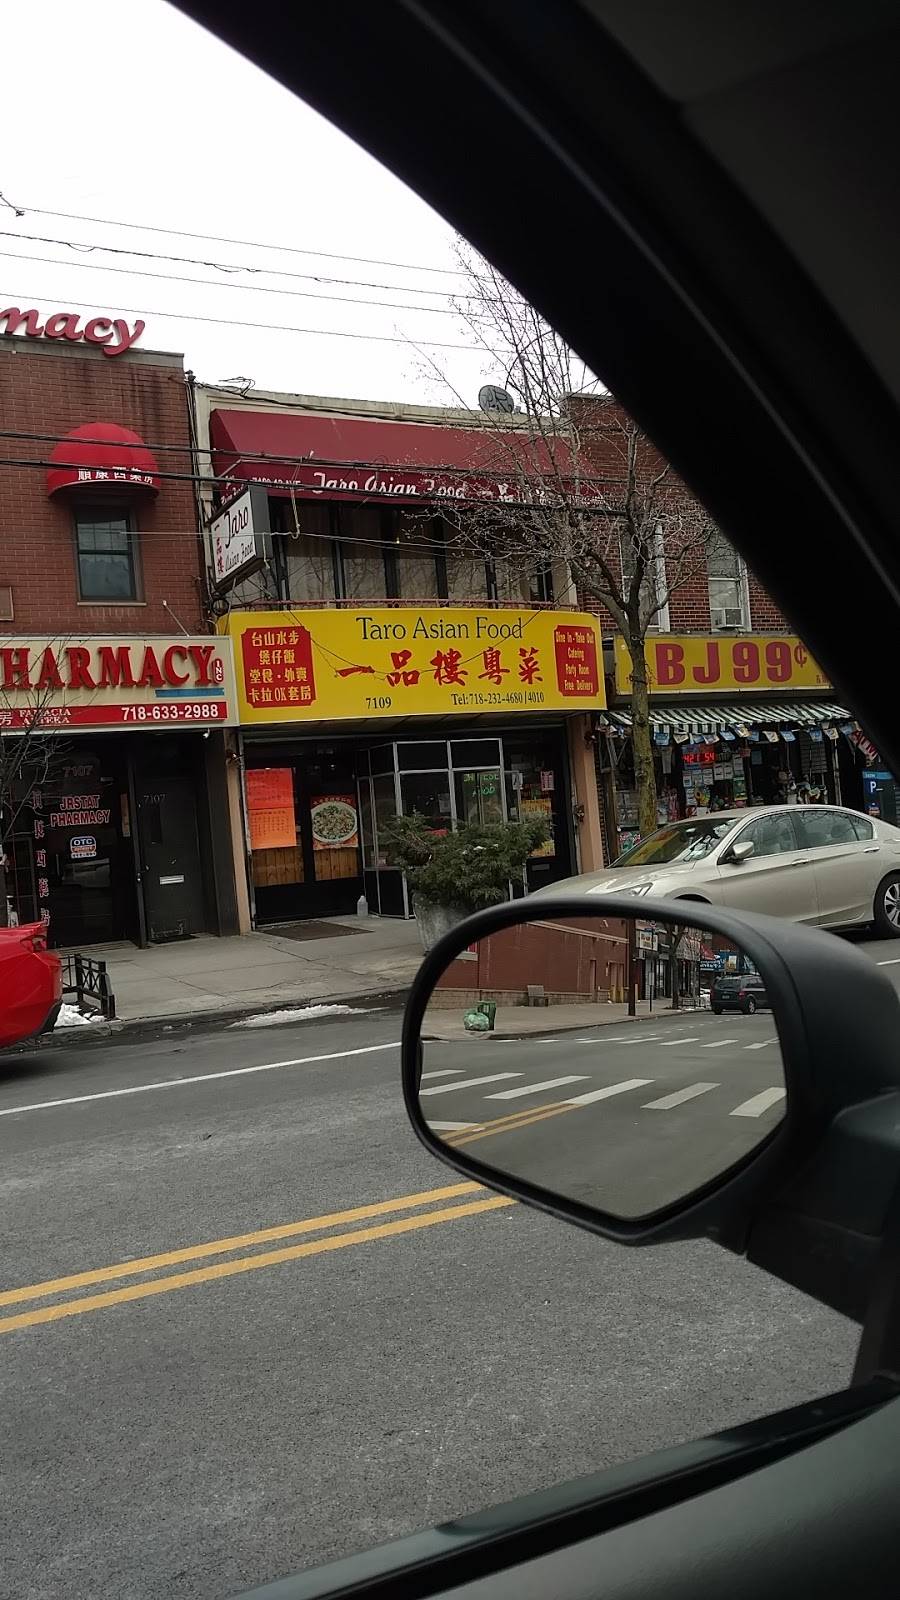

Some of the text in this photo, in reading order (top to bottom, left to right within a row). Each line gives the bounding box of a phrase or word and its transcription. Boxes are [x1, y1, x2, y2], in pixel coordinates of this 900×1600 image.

[0, 307, 145, 356] macy
[364, 475, 420, 497] Asian
[223, 506, 249, 549] Taro
[356, 616, 523, 640] Taro Asian Food
[567, 647, 585, 661] Catering
[0, 645, 215, 690] HARMACY
[215, 660, 223, 682] INC
[336, 646, 544, 687] 一品樓粵菜
[565, 663, 590, 677] Party Room
[564, 679, 594, 693] Free Delivery
[365, 696, 392, 709] 7109
[121, 704, 219, 721] 718-633-2988
[60, 795, 100, 811] JRSTAT
[50, 810, 110, 828] PHARMACY
[73, 838, 93, 846] OTC
